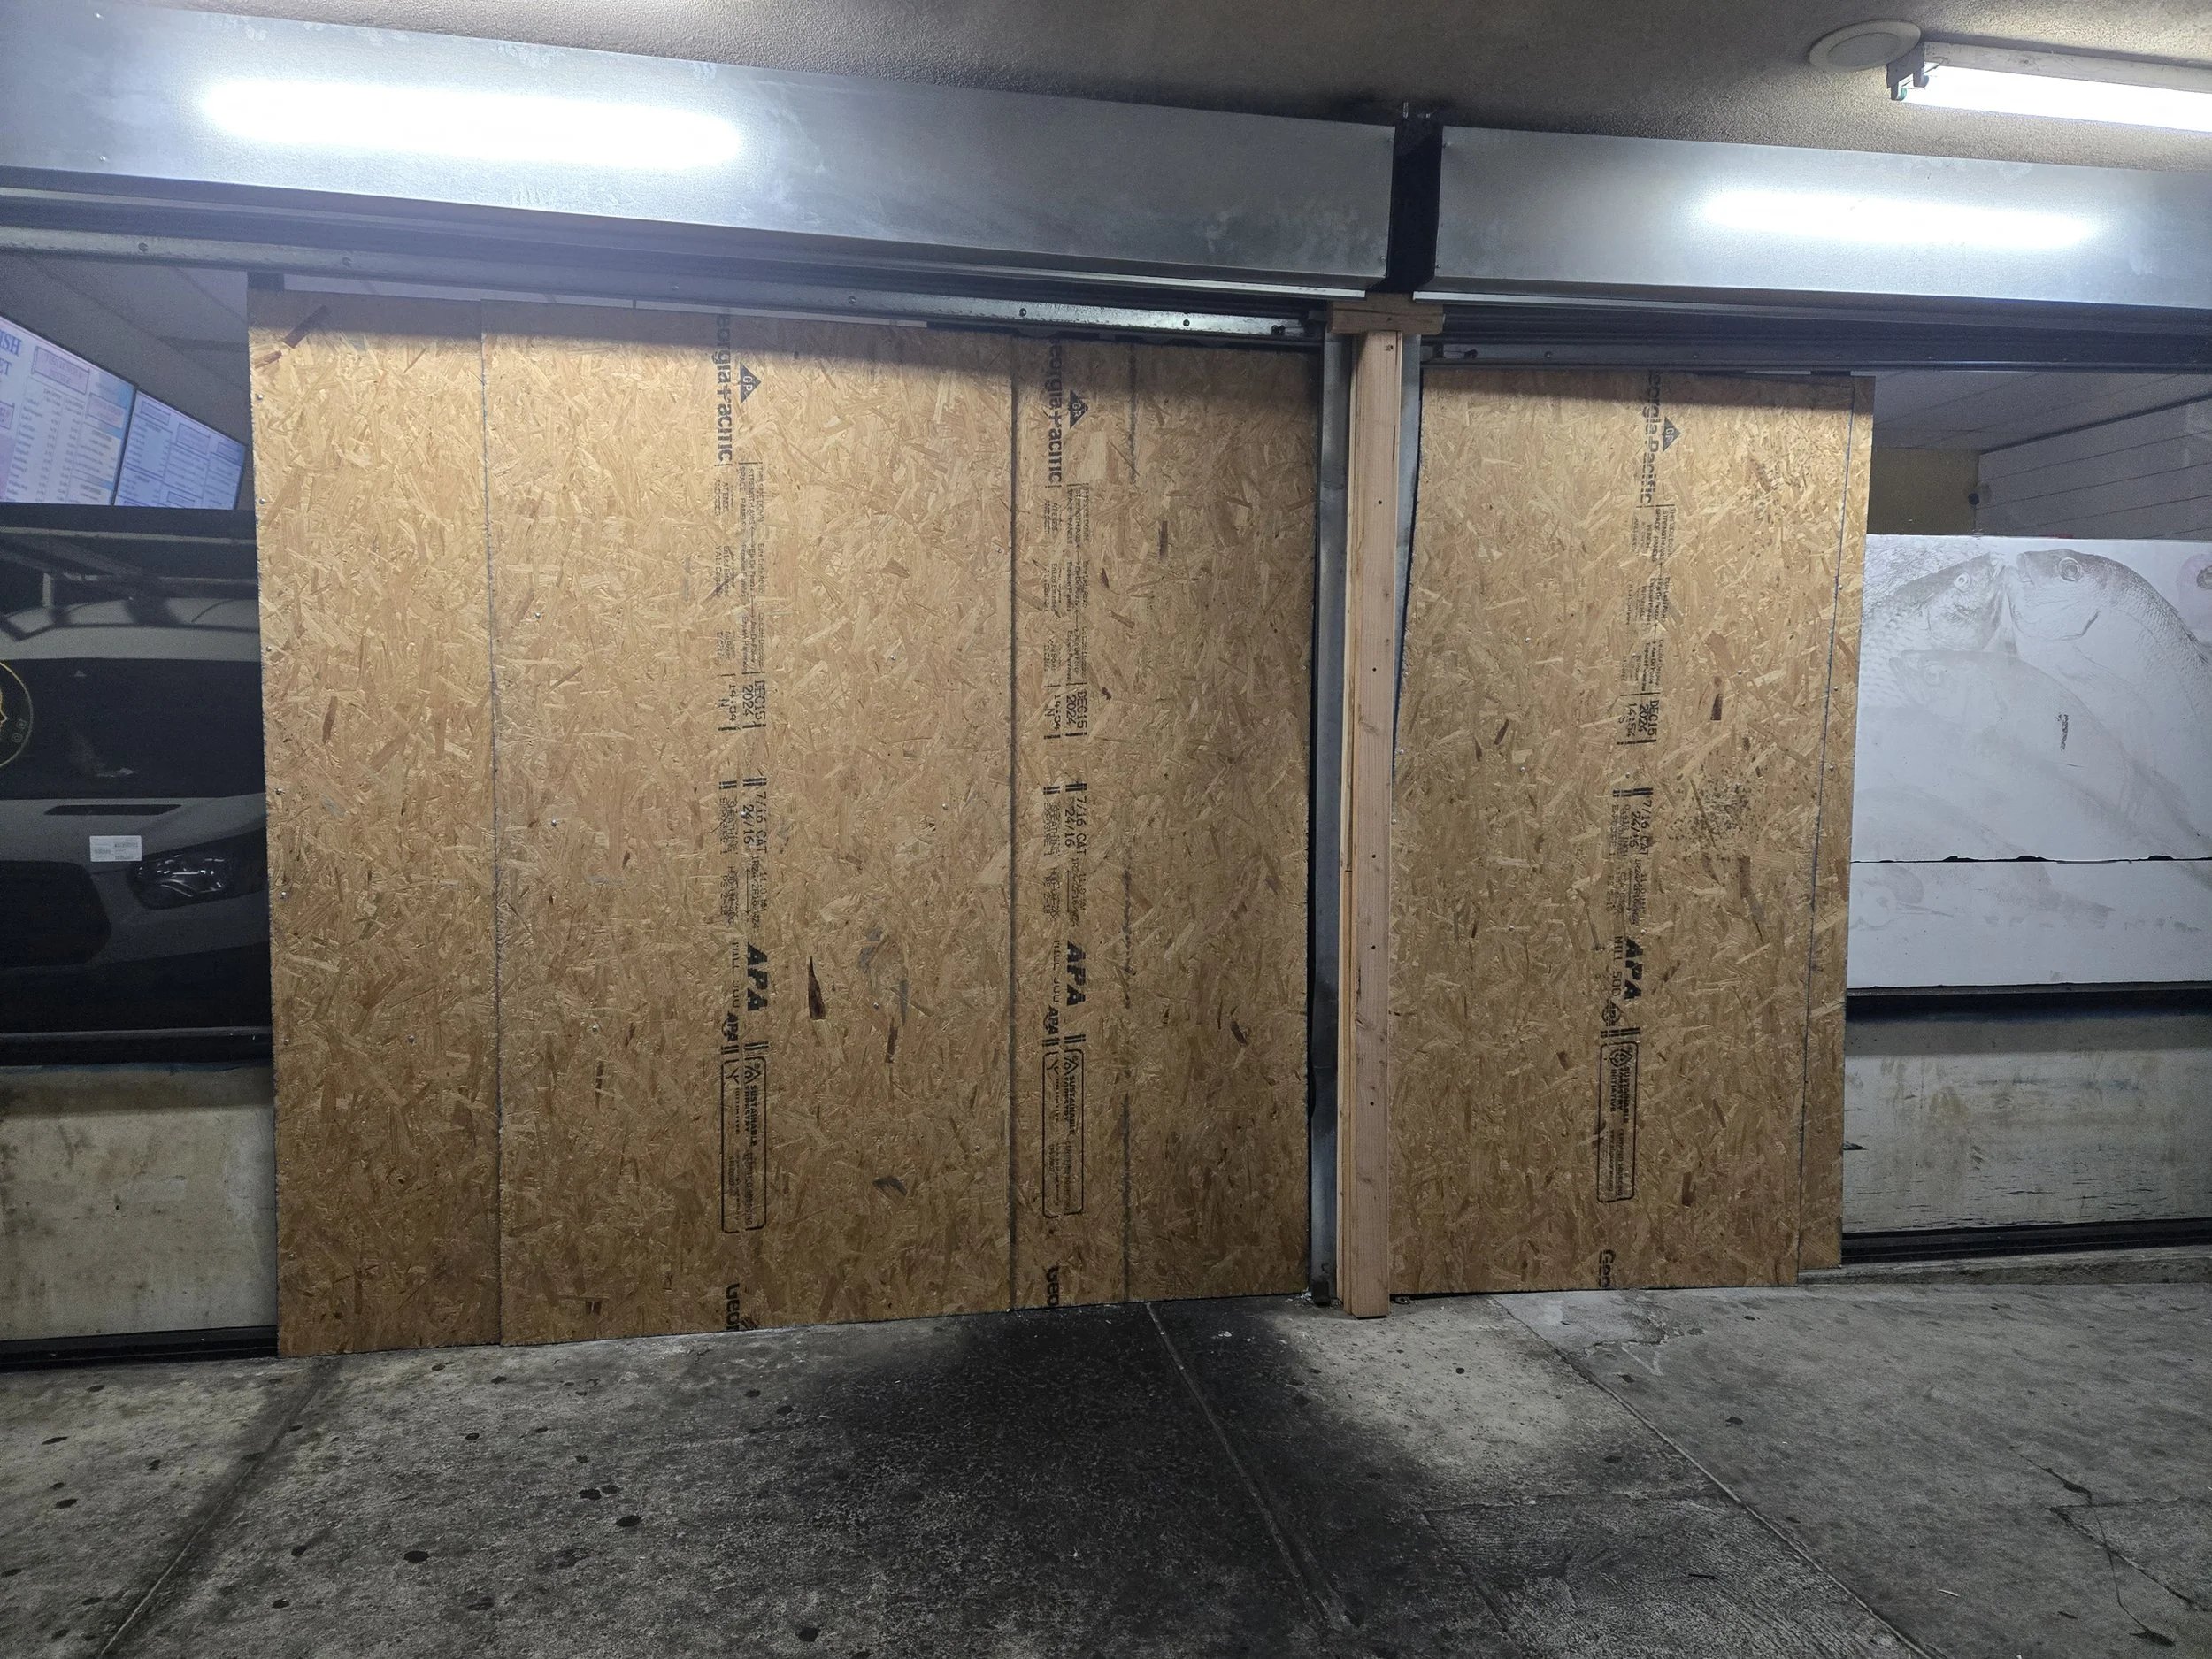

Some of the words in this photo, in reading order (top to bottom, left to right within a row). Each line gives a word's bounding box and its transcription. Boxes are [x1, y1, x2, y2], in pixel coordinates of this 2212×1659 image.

[742, 375, 753, 391] GP
[1641, 373, 1662, 504] eorgia-Pacific
[742, 686, 754, 717] 2024
[754, 680, 766, 720] DEC15
[1066, 695, 1076, 724] 2024
[1077, 691, 1087, 729] DEC15
[1626, 703, 1638, 738] 14:54
[1638, 704, 1649, 733] 2024
[1647, 699, 1660, 736] DEC15
[756, 791, 766, 823] 7/16
[1076, 796, 1087, 826] 7/16
[1640, 800, 1652, 828] 7/16
[743, 804, 754, 844] 24/16
[1065, 806, 1076, 848] 24/16
[756, 830, 766, 854] CAT
[1076, 833, 1087, 856] CAT
[1639, 836, 1650, 856] CAT
[1614, 936, 1623, 964] MILL
[747, 942, 768, 1012] APA
[1067, 940, 1087, 1007] APA
[1612, 971, 1623, 996] 500
[1624, 938, 1644, 1000] APA
[727, 1010, 739, 1042] APA
[1048, 1005, 1058, 1035] APA
